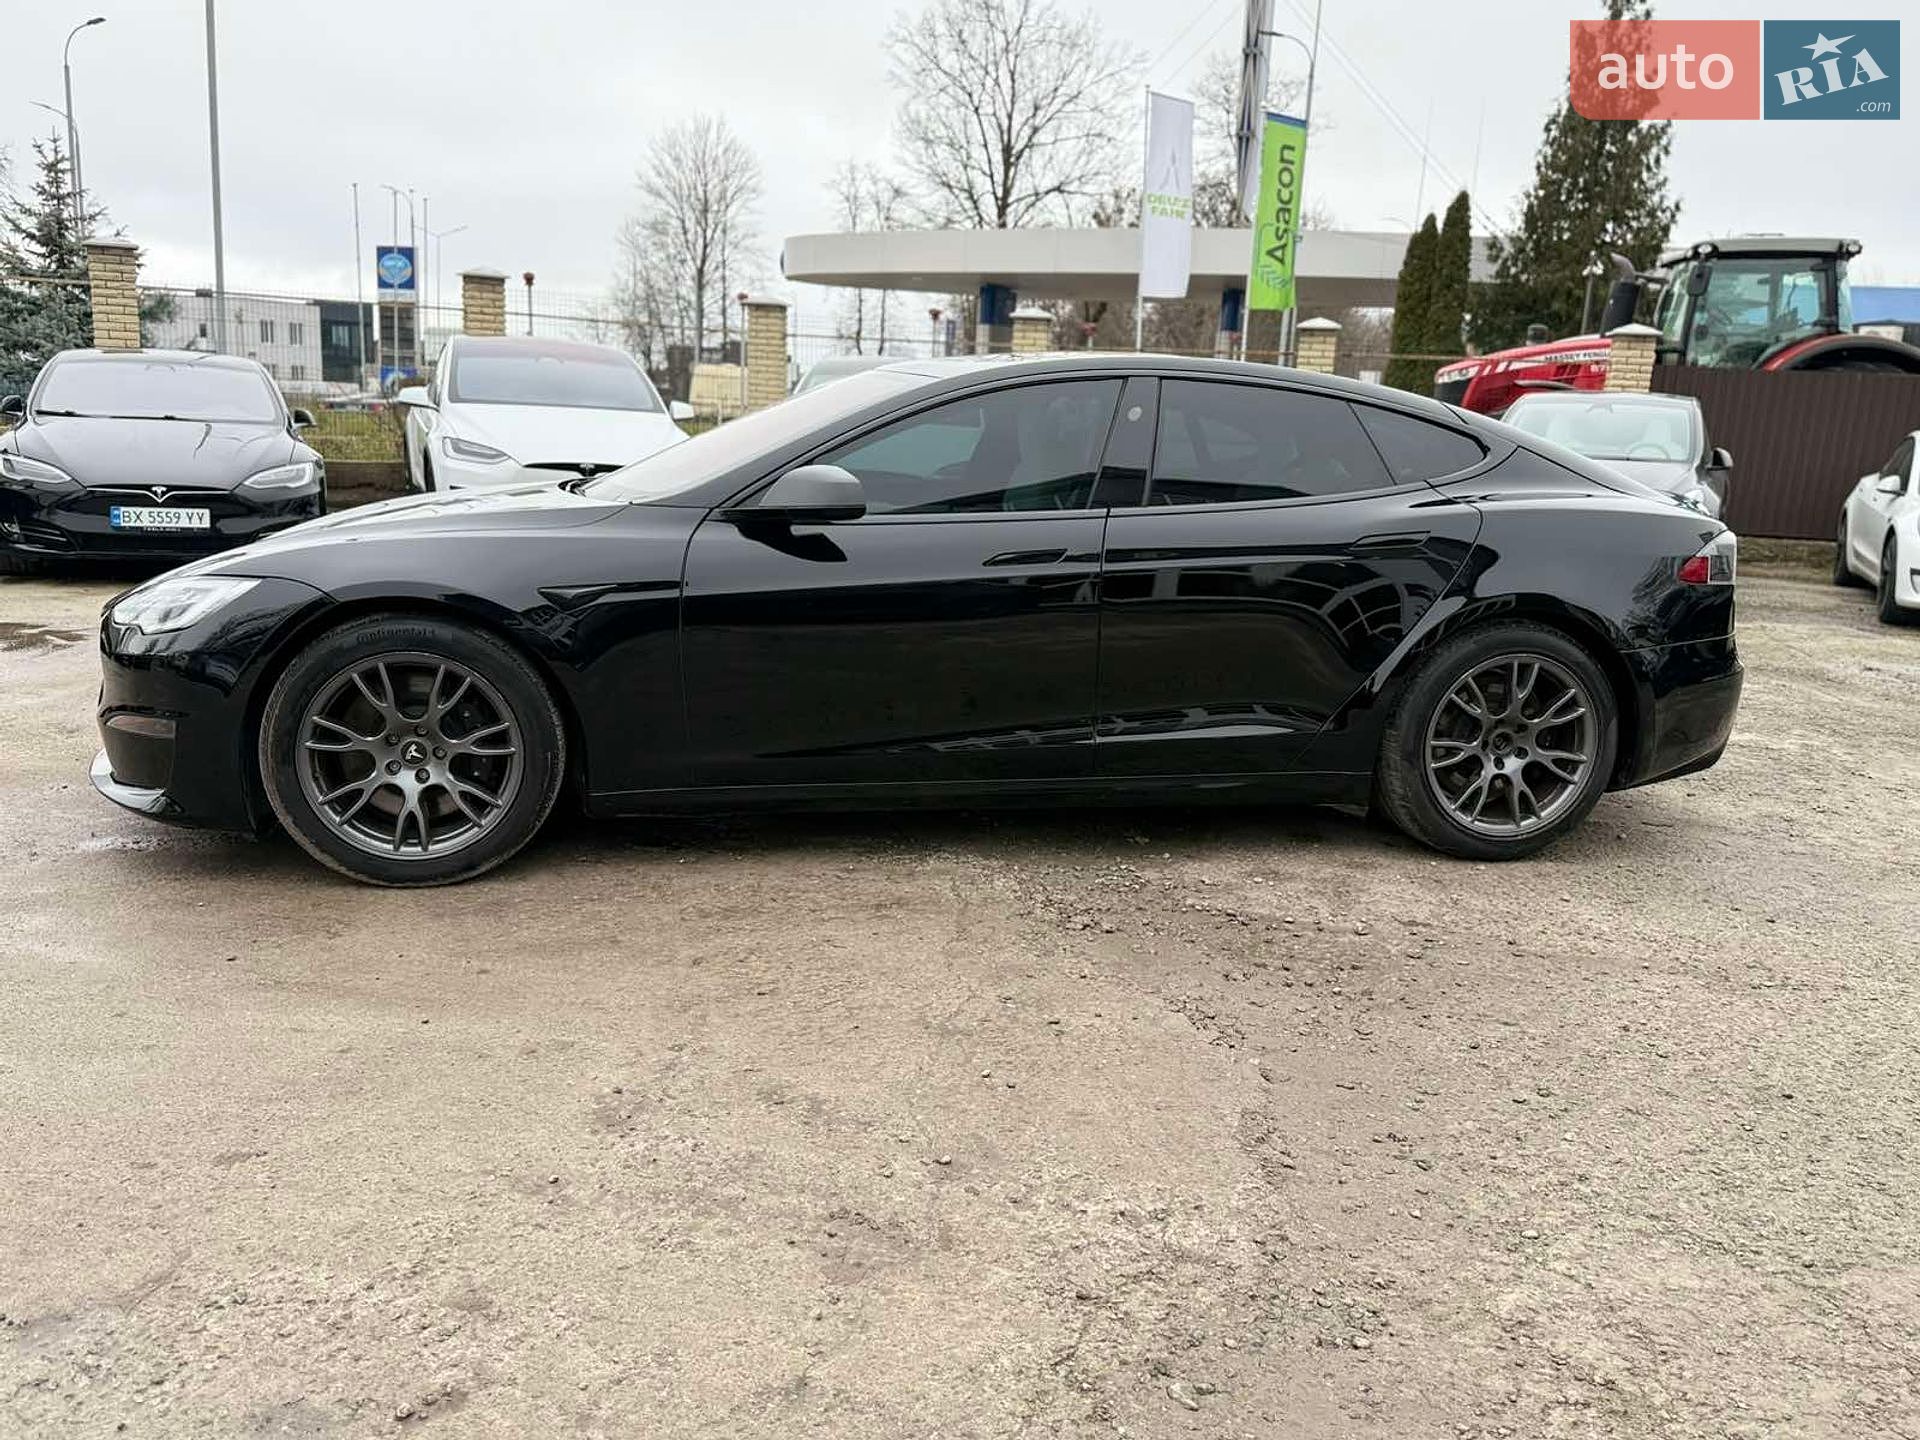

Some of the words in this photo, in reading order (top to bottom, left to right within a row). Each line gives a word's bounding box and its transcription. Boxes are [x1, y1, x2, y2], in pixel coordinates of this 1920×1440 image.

[1265, 143, 1297, 266] Asacon
[122, 510, 143, 524] BX
[148, 511, 181, 525] 5559
[186, 512, 205, 525] YY
